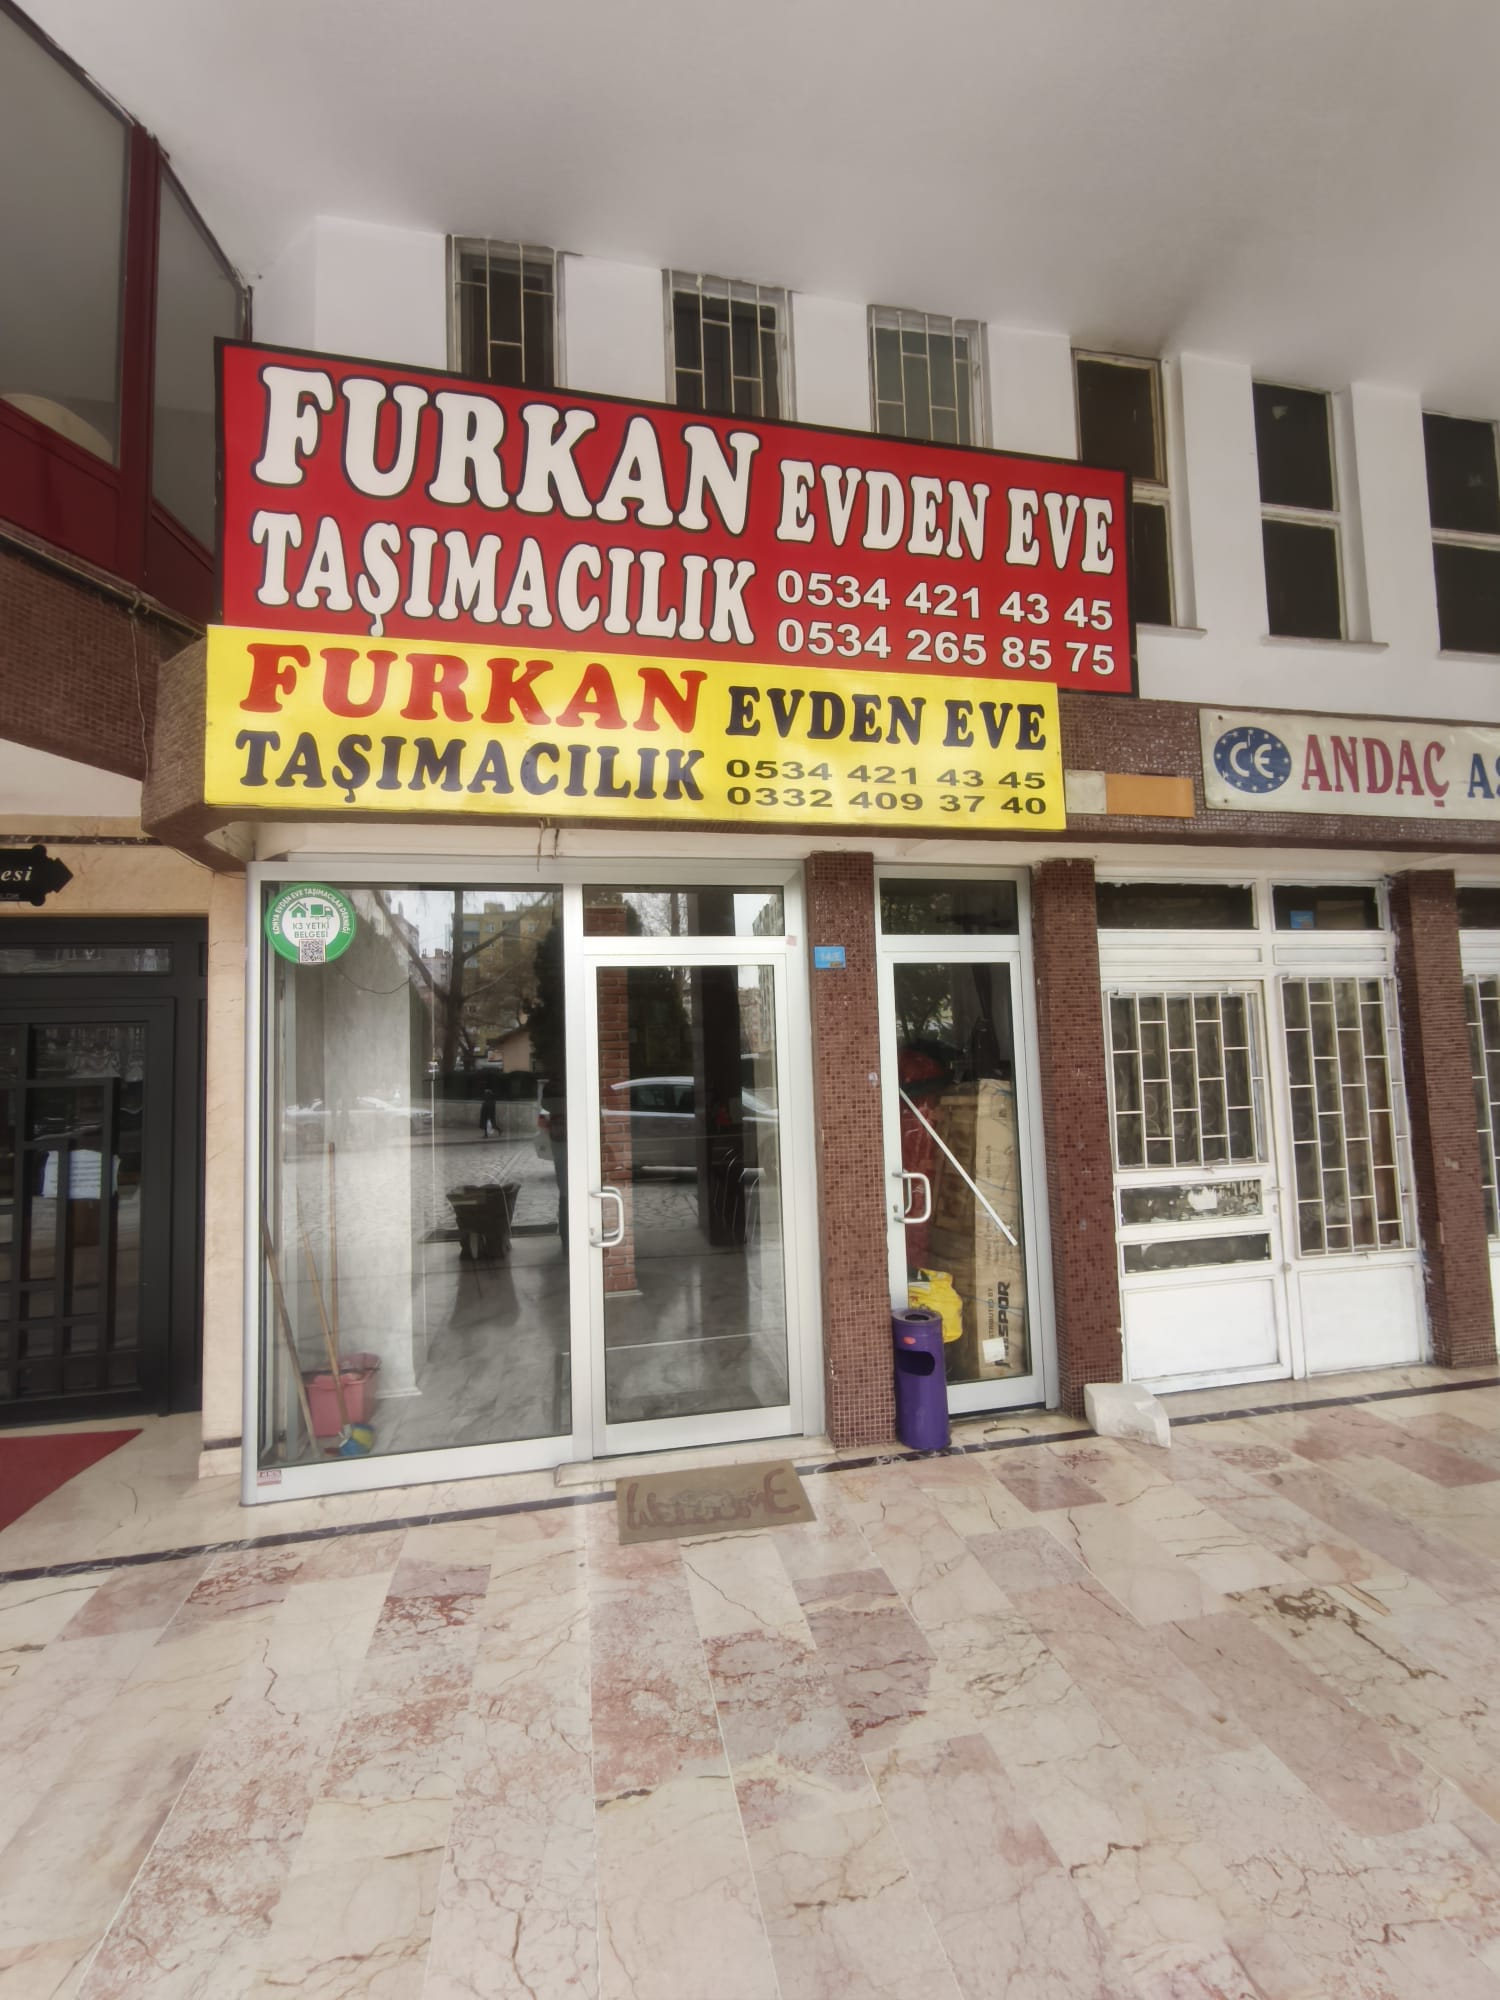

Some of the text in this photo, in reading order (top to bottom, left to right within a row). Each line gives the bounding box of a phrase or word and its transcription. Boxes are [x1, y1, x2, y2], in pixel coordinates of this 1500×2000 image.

[254, 365, 1114, 575] FURKAN EVDEN EVE
[251, 510, 757, 645] TAŞIMACILIK
[776, 569, 1113, 631] 0534 421 43 45
[777, 618, 1115, 675] 0534 265 85 75
[239, 643, 1047, 751] FURKAN EVDEN EVE
[235, 729, 705, 803] TAŞIMACILIK
[726, 759, 1046, 790] 0534 421 43 45
[726, 786, 1046, 815] 0332 409 37 40
[1302, 734, 1500, 807] ANDAÇ A
